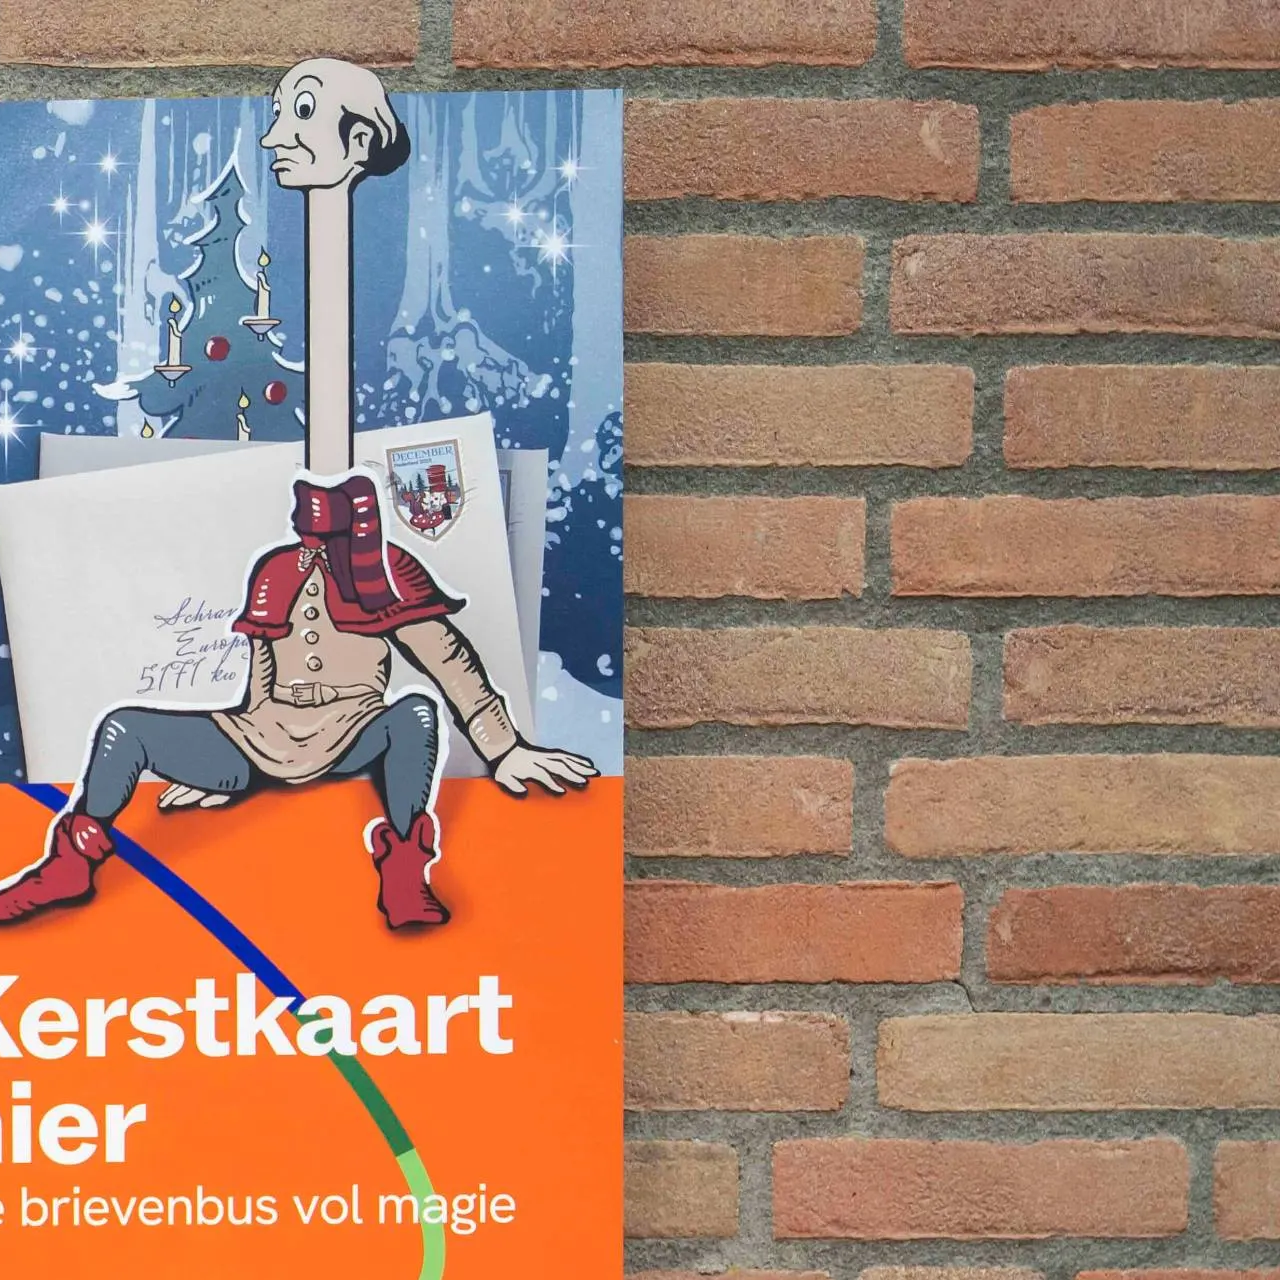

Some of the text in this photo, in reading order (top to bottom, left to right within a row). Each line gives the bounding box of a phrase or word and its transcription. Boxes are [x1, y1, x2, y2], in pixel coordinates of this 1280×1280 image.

[392, 446, 454, 462] DECEMBER
[20, 1184, 279, 1227] brievenbus
[292, 1183, 364, 1225] vol
[378, 1183, 517, 1235] magie
